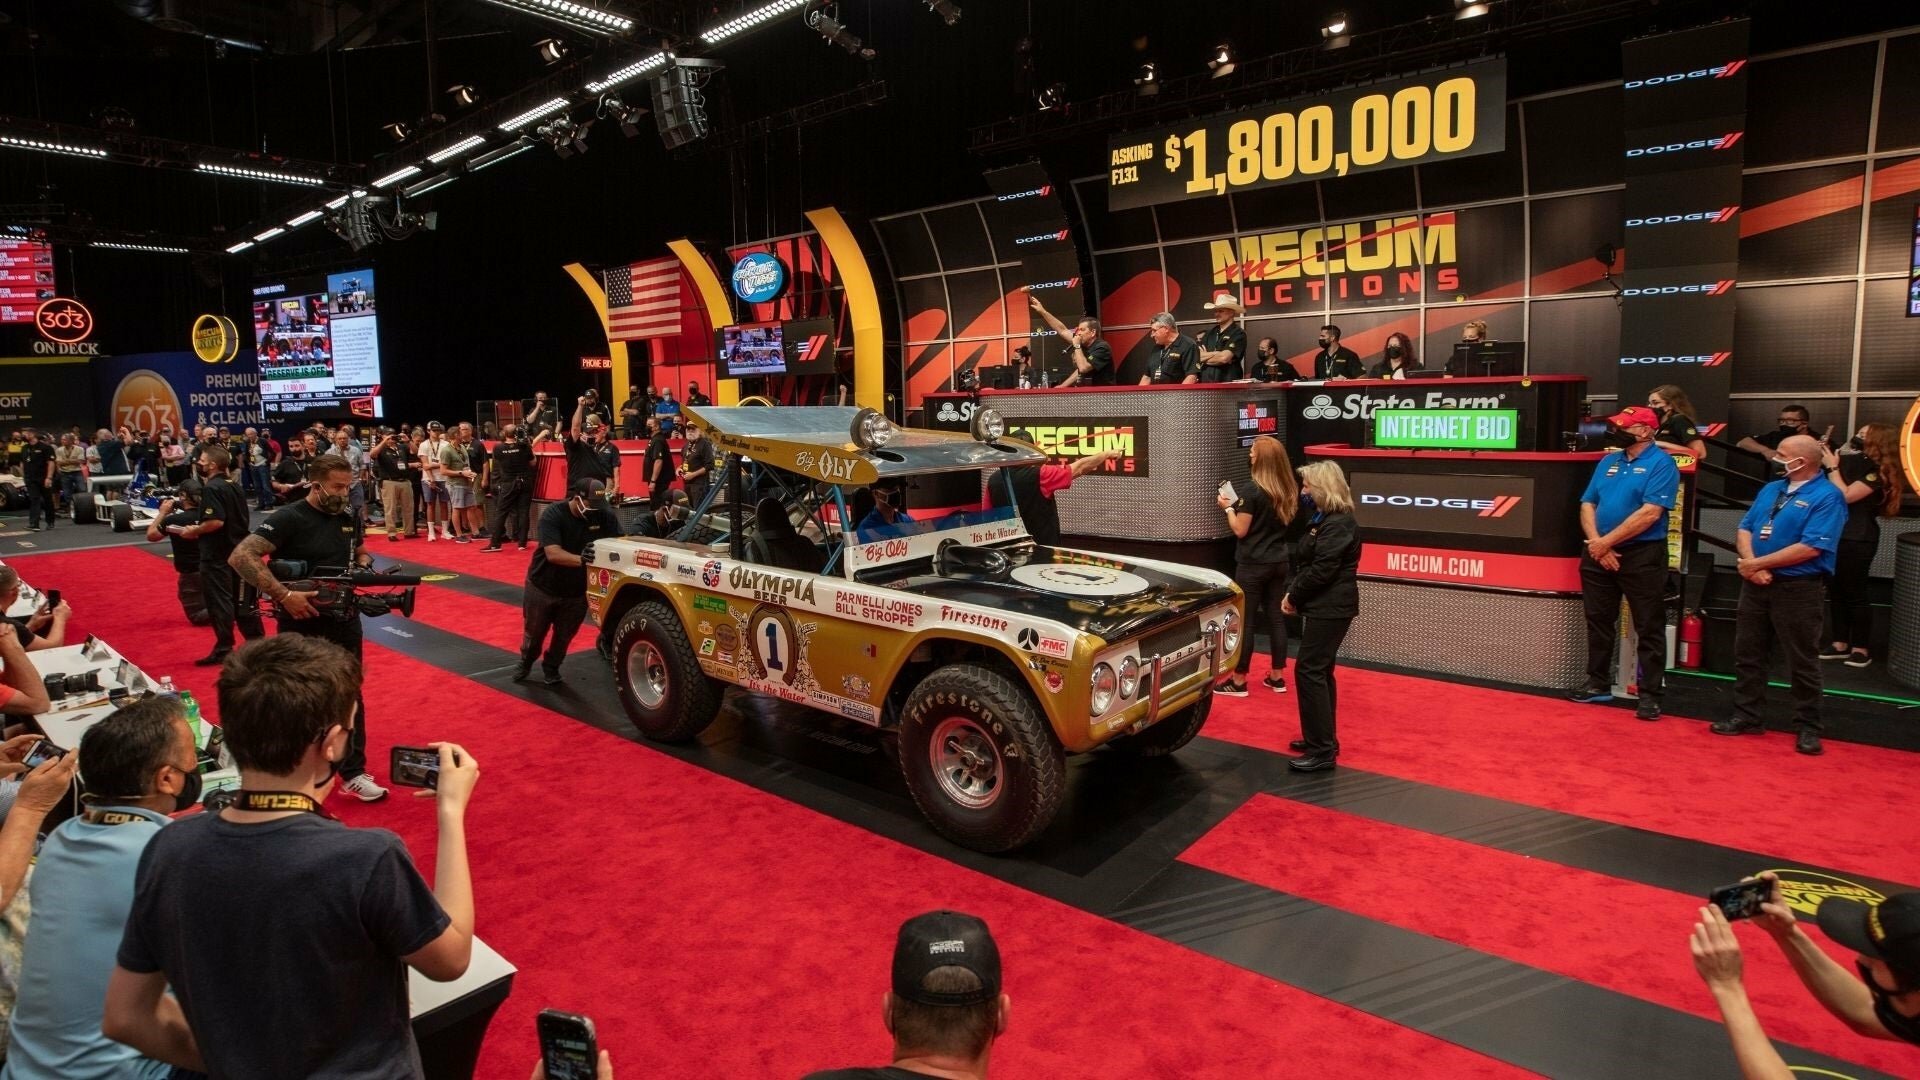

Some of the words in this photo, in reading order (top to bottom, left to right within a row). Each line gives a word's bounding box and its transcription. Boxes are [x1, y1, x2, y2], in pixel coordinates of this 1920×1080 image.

[1624, 65, 1728, 89] DODGE
[1165, 77, 1476, 195] $1,800,000
[1111, 141, 1153, 166] ASKING
[1625, 136, 1725, 157] DODGE
[1111, 167, 1139, 186] F131
[998, 188, 1044, 201] DODGE
[1625, 210, 1721, 227] DODGE
[1015, 232, 1061, 244] DODGE
[1210, 211, 1457, 285] MECUM
[1028, 280, 1073, 290] DODGE
[1623, 284, 1718, 296] DODGE
[41, 310, 85, 329] 303
[1030, 329, 1057, 337] DOD
[33, 341, 56, 354] ON
[59, 342, 100, 355] DECK
[582, 358, 601, 368] PHONE
[602, 359, 613, 369] BID
[1619, 355, 1713, 365] DODGE
[267, 368, 301, 379] RESERVE
[301, 367, 309, 376] IS
[311, 365, 326, 376] OFF
[206, 374, 257, 389] PREMIU
[190, 391, 260, 406] PROTECTA
[334, 387, 375, 395] DODGE
[118, 404, 174, 437] 303
[198, 412, 207, 425] &
[210, 410, 285, 425] CLEANE
[1381, 415, 1471, 440] INTERNET
[1476, 416, 1510, 440] BID
[796, 450, 816, 472] Big
[817, 447, 860, 481] OLY
[1361, 494, 1496, 511] DODGE
[985, 530, 996, 541] the
[865, 545, 884, 562] Big
[886, 540, 908, 558] Oly
[1387, 552, 1485, 578] MECUM.COM
[729, 565, 817, 606] OLYMPIA
[753, 590, 788, 606] BEER
[836, 590, 885, 609] PARNELLI
[886, 600, 923, 617] JONES
[835, 602, 857, 616] BILL
[862, 607, 915, 627] STROPPE
[941, 605, 1008, 632] Firestone
[765, 623, 784, 672] 1
[1042, 639, 1066, 652] FMC
[764, 684, 778, 696] the
[778, 687, 806, 703] Water
[813, 691, 838, 705] SIMPSON
[842, 700, 873, 713] CRAGAR
[910, 691, 1004, 736] Firestone
